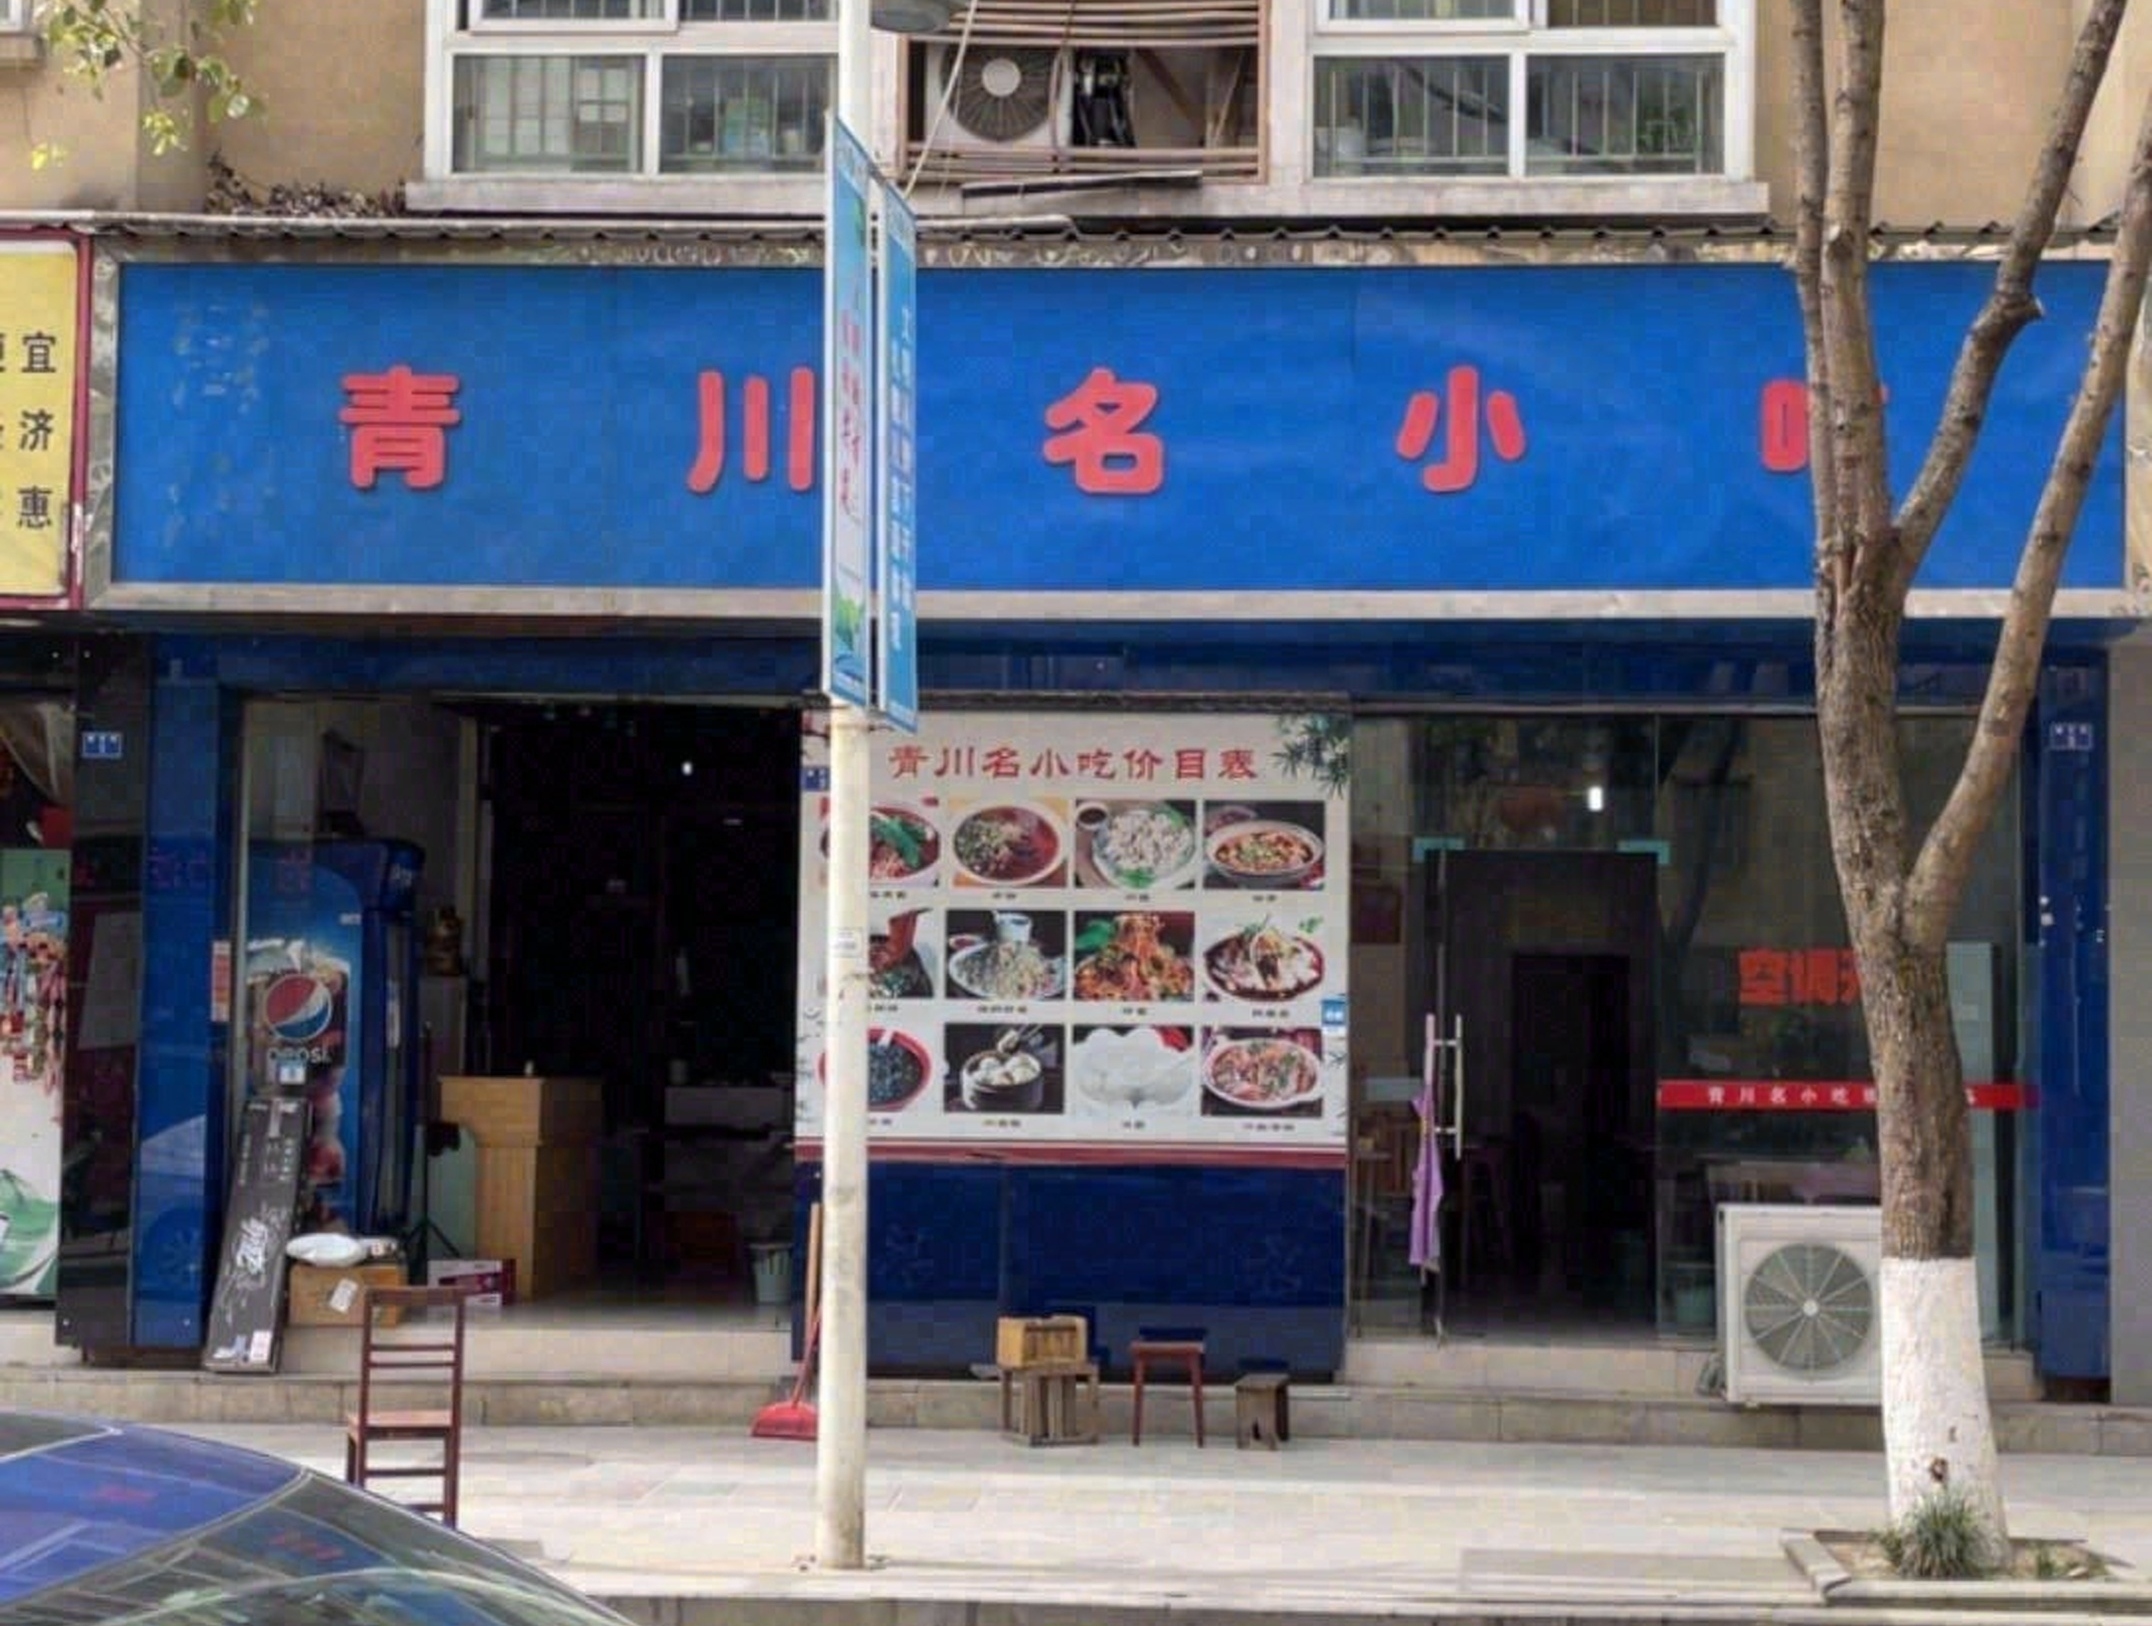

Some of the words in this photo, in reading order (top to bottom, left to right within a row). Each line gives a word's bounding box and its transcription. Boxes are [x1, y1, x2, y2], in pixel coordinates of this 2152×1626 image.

[889, 744, 1259, 782] 青川名小吃价目表
